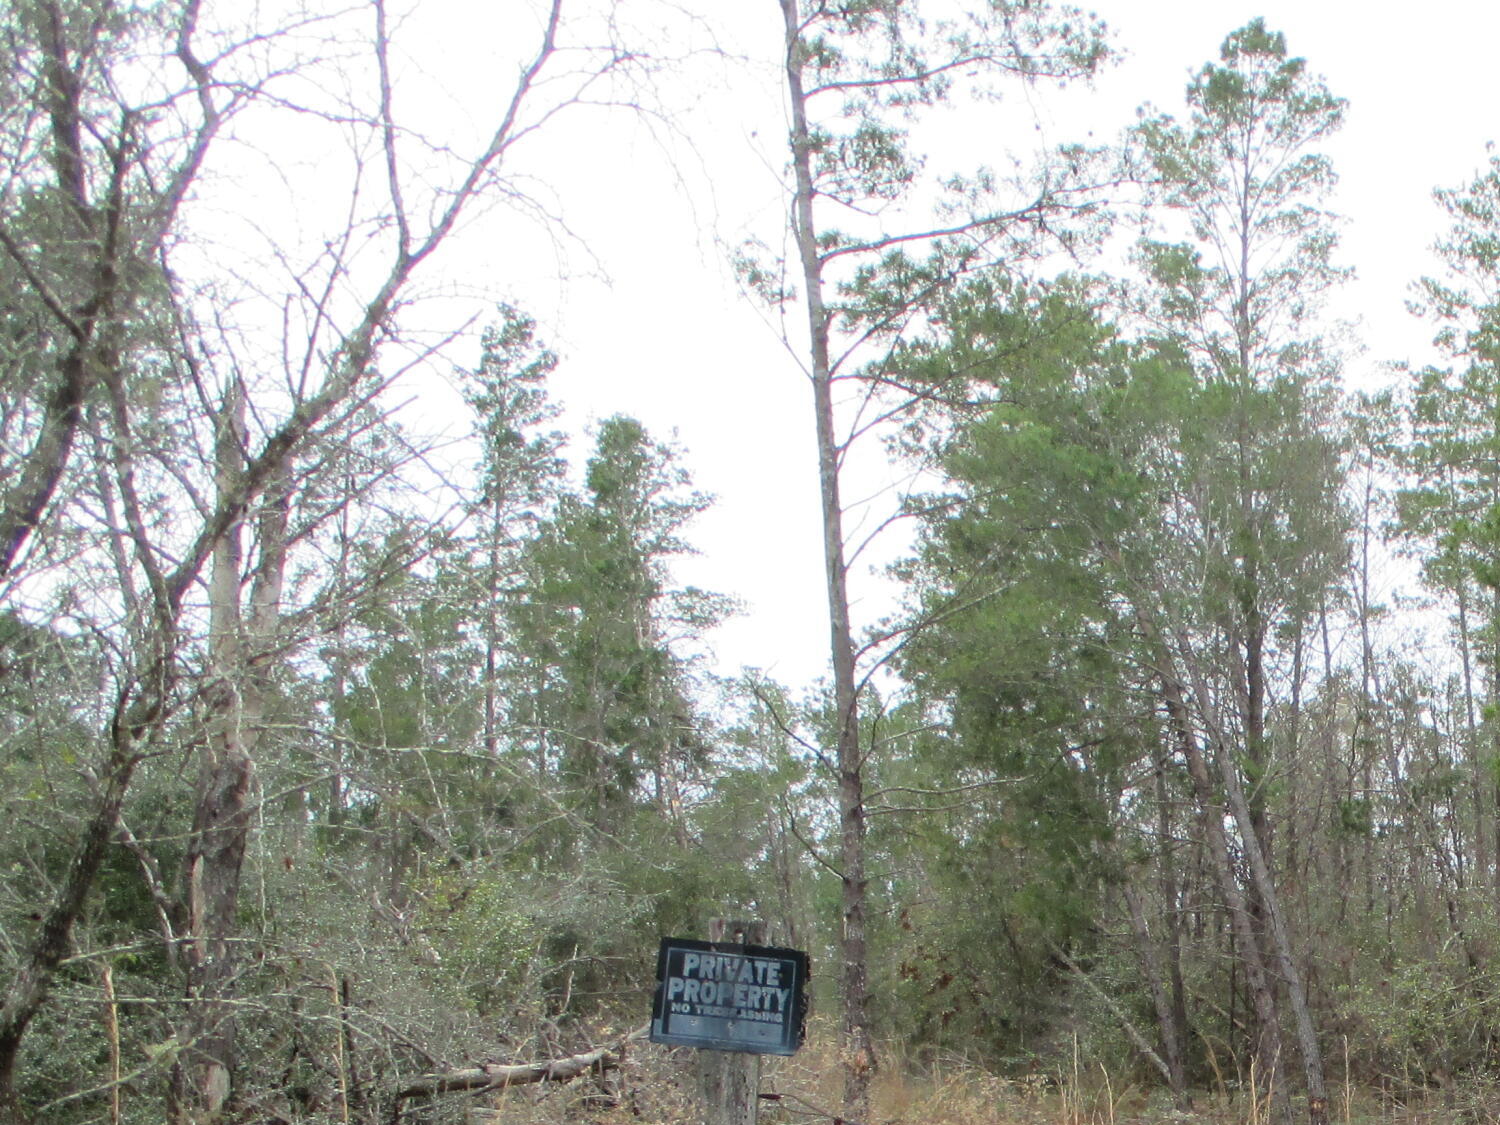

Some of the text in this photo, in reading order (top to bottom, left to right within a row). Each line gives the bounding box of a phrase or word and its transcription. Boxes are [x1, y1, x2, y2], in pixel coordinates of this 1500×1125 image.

[683, 953, 781, 985] PRIVATE
[668, 977, 790, 1011] PROPERTY
[671, 1002, 690, 1013] NO
